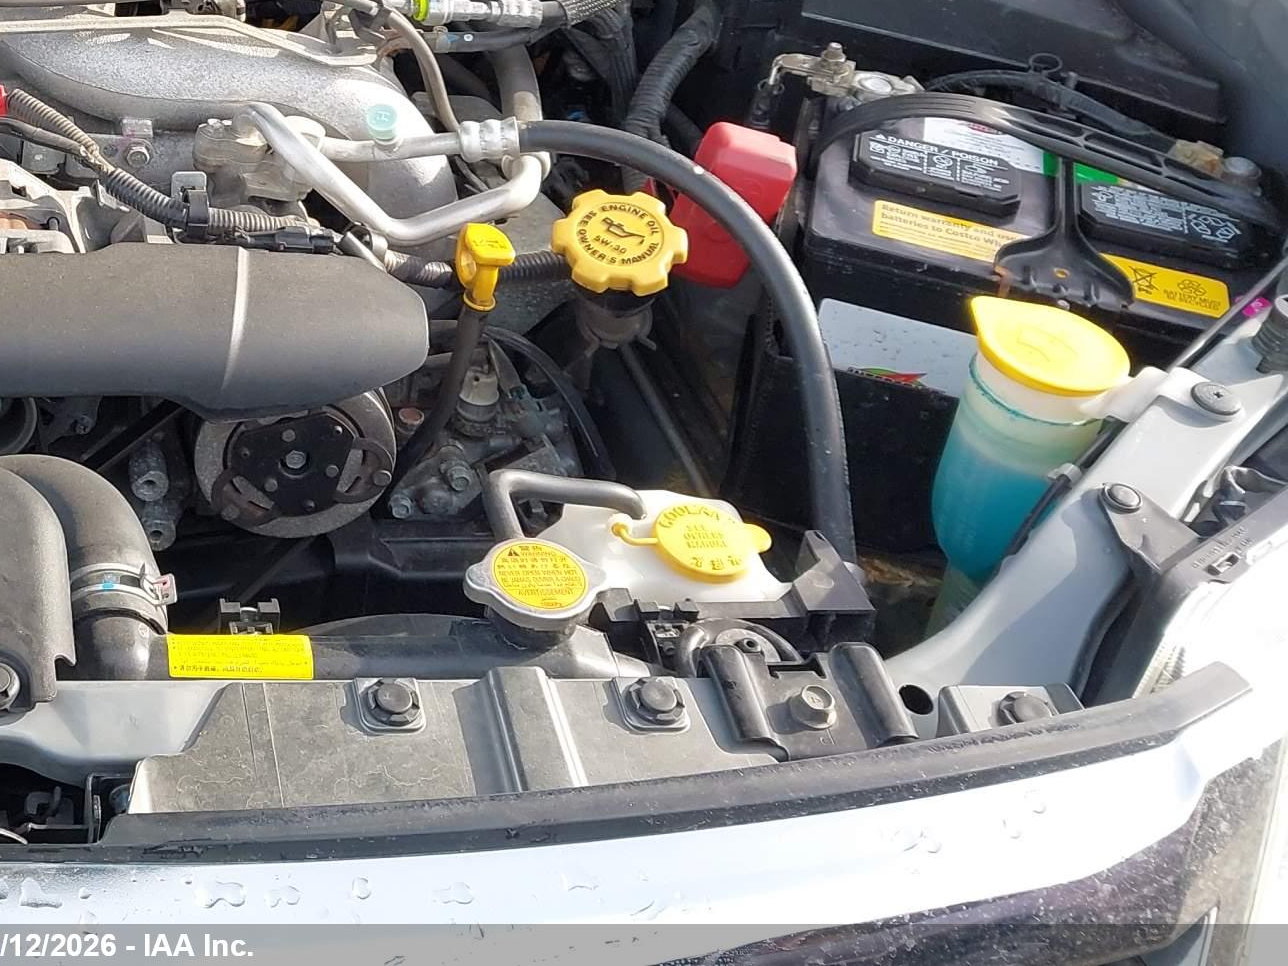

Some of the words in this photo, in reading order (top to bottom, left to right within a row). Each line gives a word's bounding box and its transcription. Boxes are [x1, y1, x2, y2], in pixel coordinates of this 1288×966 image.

[886, 136, 938, 153] DANGER
[951, 150, 999, 166] POISON
[577, 210, 597, 227] SEE
[601, 204, 648, 220] ENGINE
[647, 220, 660, 236] OIL
[881, 204, 919, 218] Return
[974, 225, 994, 237] and
[997, 233, 1018, 241] use
[881, 212, 929, 230] batteries
[931, 225, 943, 233] to
[945, 227, 981, 242] Costco
[983, 236, 1002, 247] Wh
[620, 242, 660, 265] MANUAL
